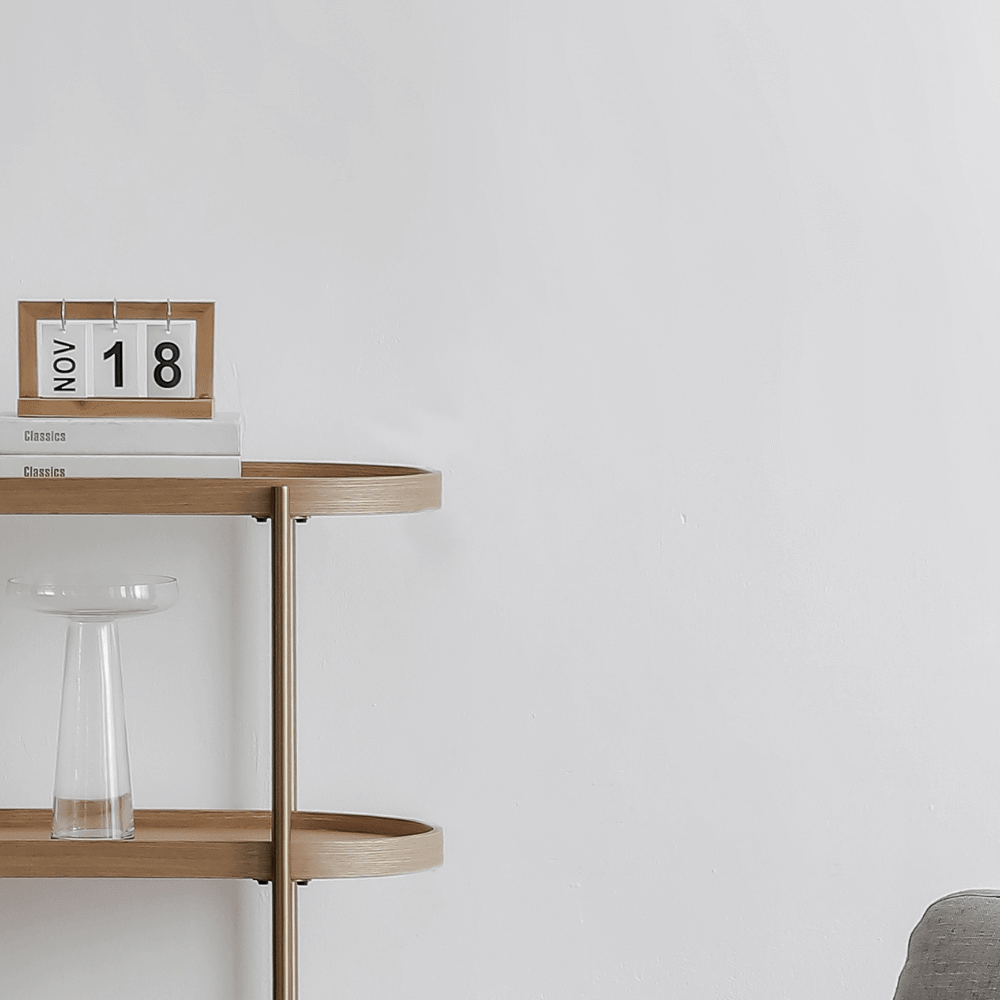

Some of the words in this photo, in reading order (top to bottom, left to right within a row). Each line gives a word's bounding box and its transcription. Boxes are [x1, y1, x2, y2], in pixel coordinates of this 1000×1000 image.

[53, 339, 76, 391] NOV
[23, 429, 67, 443] Classics
[23, 465, 66, 478] Classics
